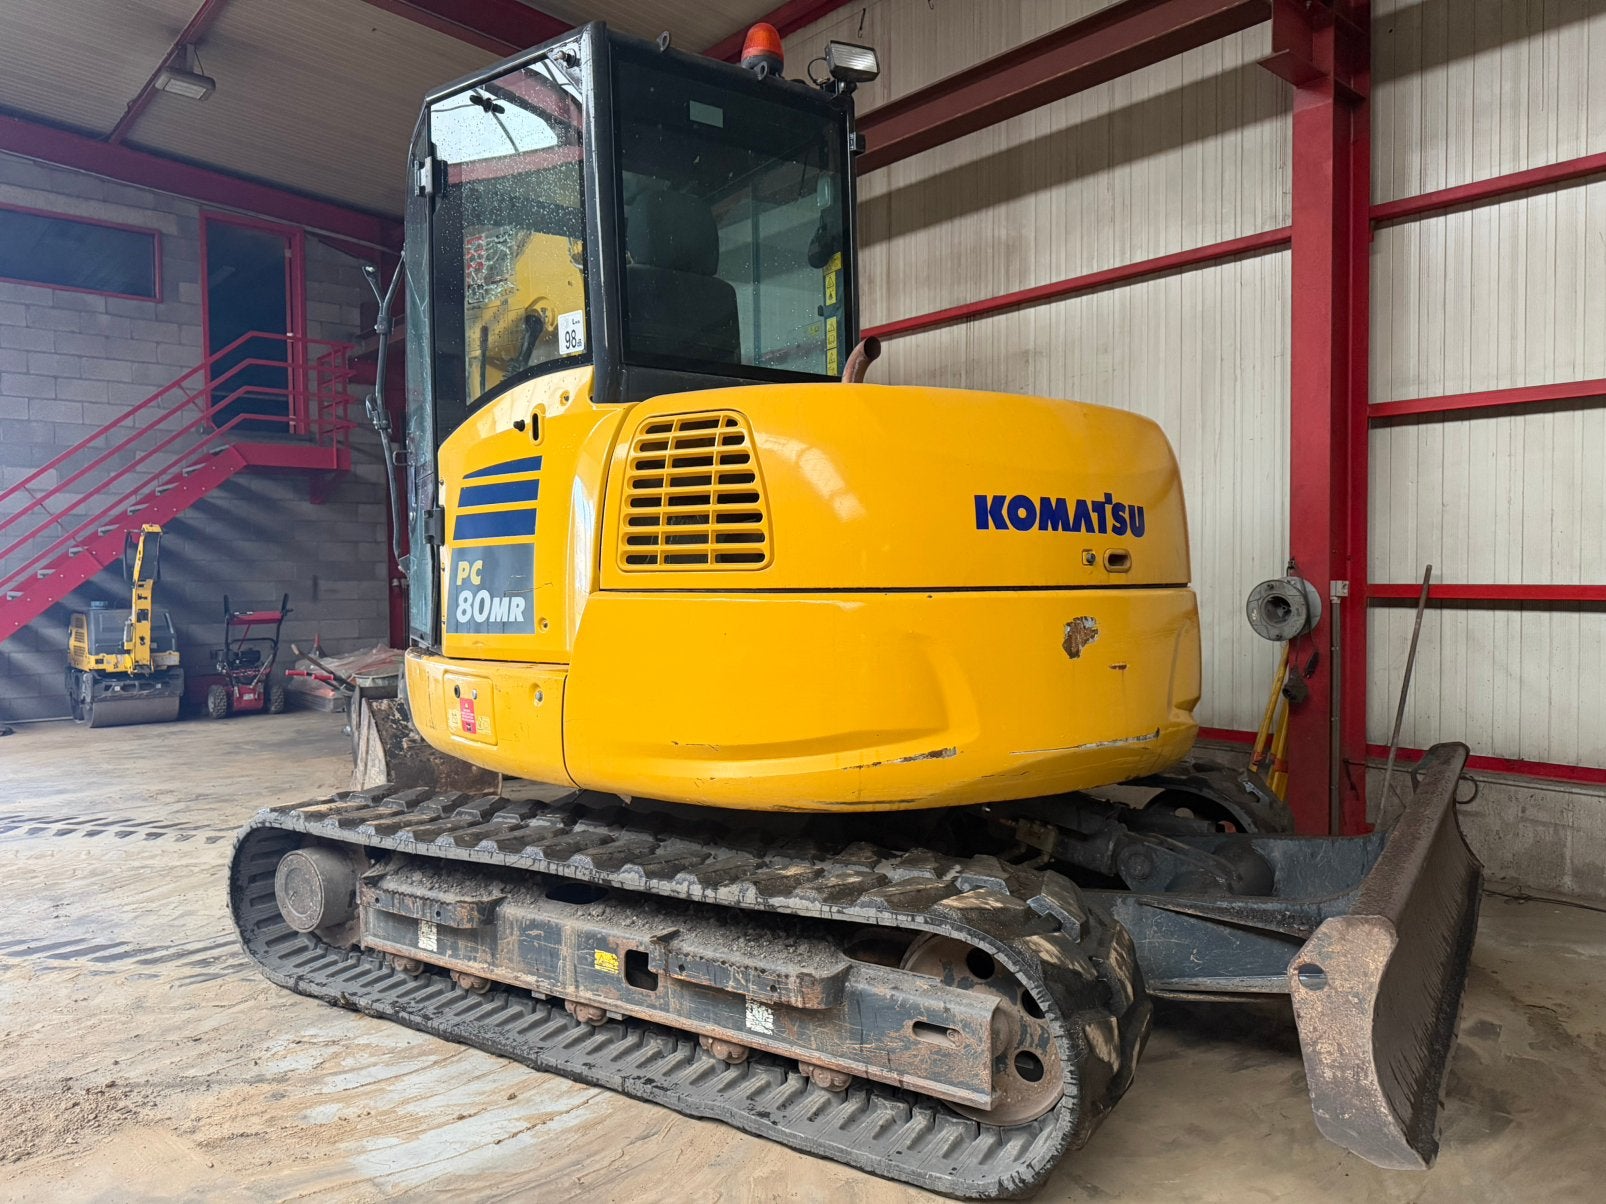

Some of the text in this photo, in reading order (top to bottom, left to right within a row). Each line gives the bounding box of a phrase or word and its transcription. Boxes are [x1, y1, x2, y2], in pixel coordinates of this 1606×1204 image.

[565, 329, 577, 349] 98
[974, 492, 1146, 538] KOMATSU
[456, 560, 483, 586] PC
[456, 589, 526, 623] 80MR
